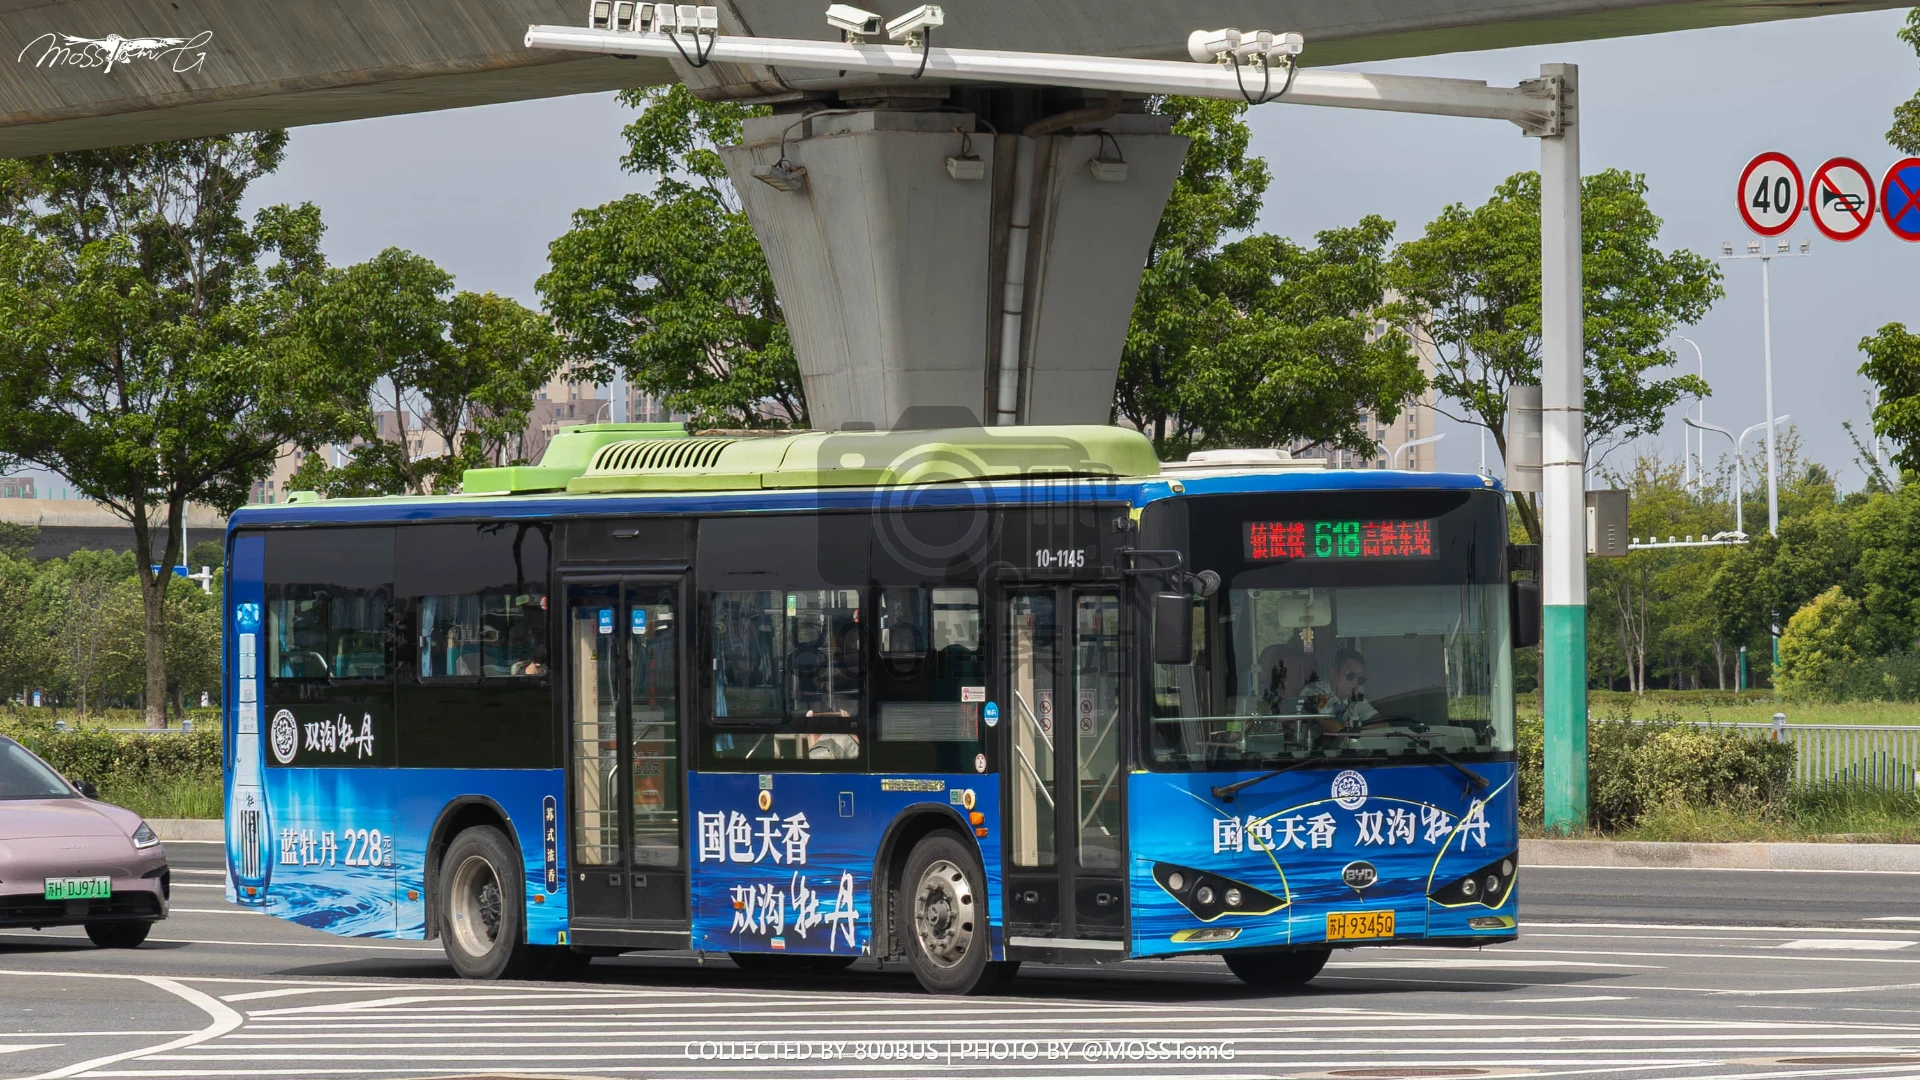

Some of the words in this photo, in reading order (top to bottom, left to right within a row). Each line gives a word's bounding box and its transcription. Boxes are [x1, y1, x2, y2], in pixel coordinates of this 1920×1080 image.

[1752, 175, 1791, 214] 40
[1035, 548, 1085, 568] 10-1145
[1314, 521, 1360, 558] 618
[1362, 520, 1432, 557] 高铁东站
[304, 711, 375, 760] 双沟牡丹
[698, 810, 811, 865] 国色天香
[1213, 812, 1337, 853] 国色天香
[1354, 798, 1490, 851] 双沟牡丹
[279, 828, 338, 867] 蓝牡丹
[344, 828, 383, 867] 228
[1346, 868, 1374, 881] BYD
[729, 869, 860, 953] 双沟牡丹
